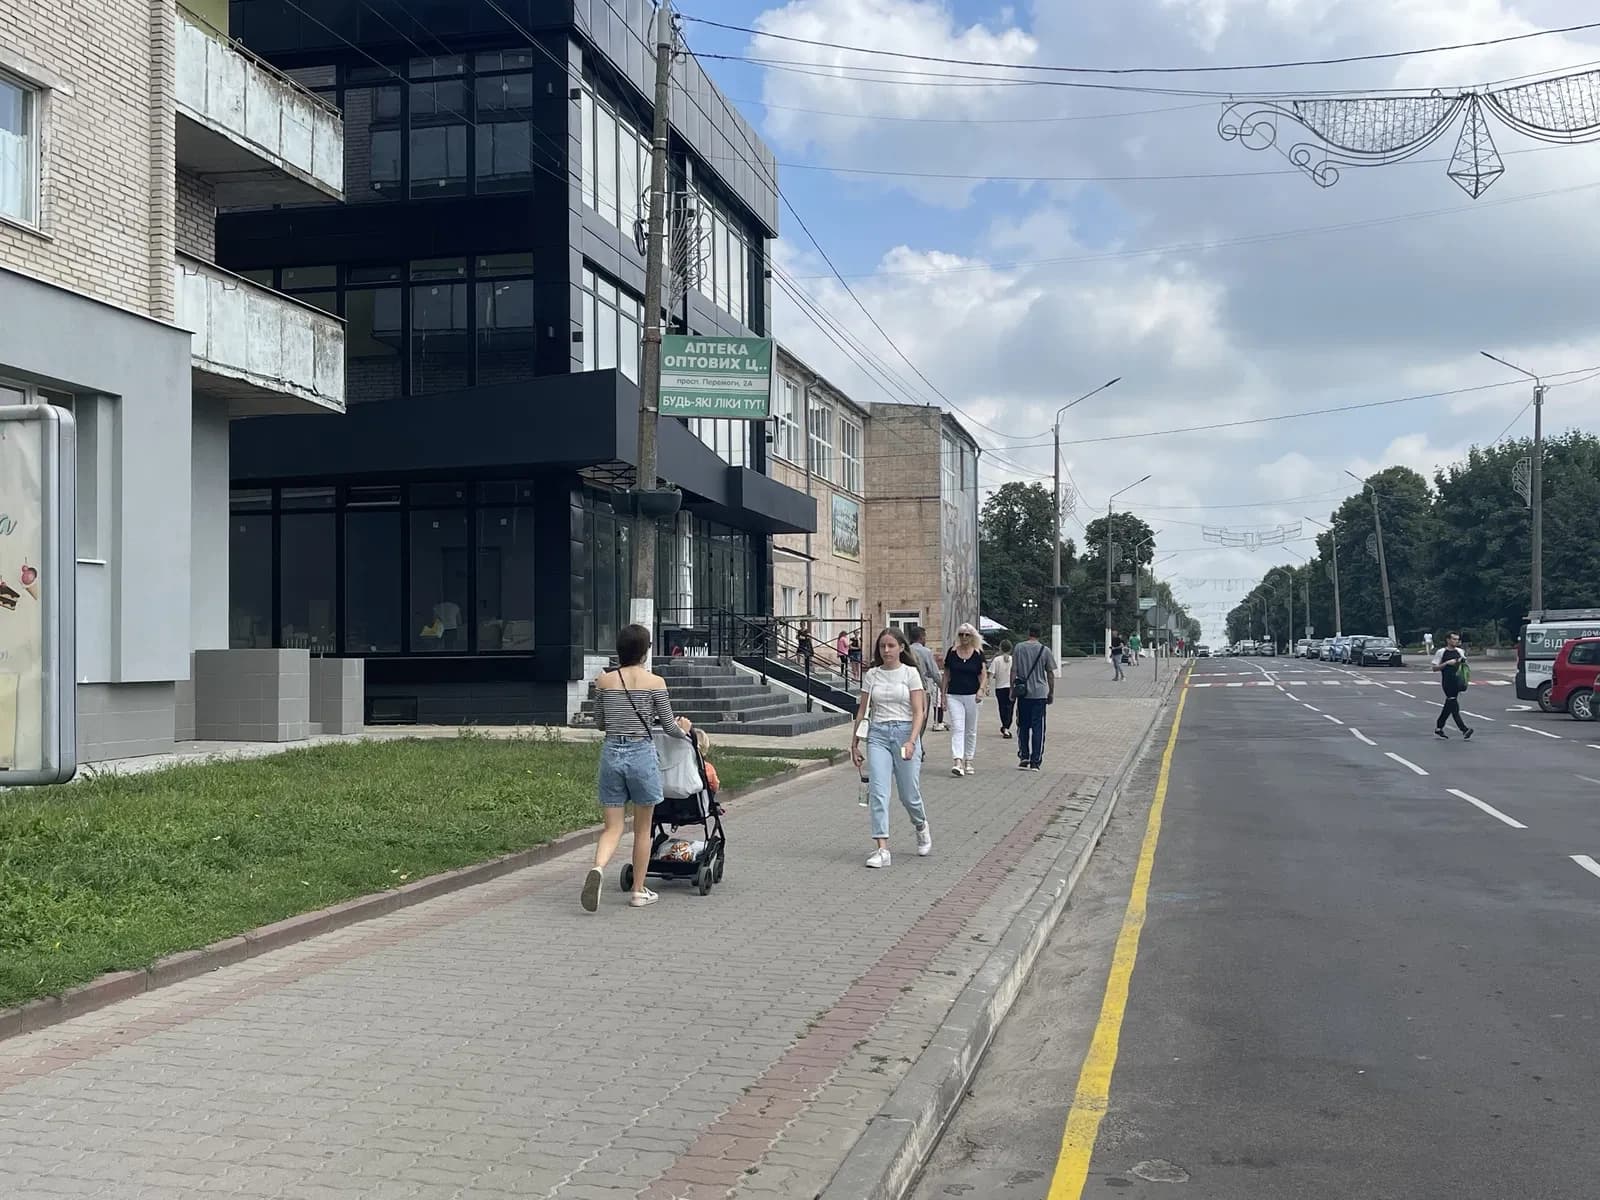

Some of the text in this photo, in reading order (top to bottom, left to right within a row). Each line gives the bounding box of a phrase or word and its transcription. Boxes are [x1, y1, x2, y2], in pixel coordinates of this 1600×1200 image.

[685, 342, 749, 355] АПТЕКА
[664, 356, 740, 369] ОПТОВИХ
[663, 396, 765, 409] БУДЬ-ЯКІ ЛІКИ ТУТ!
